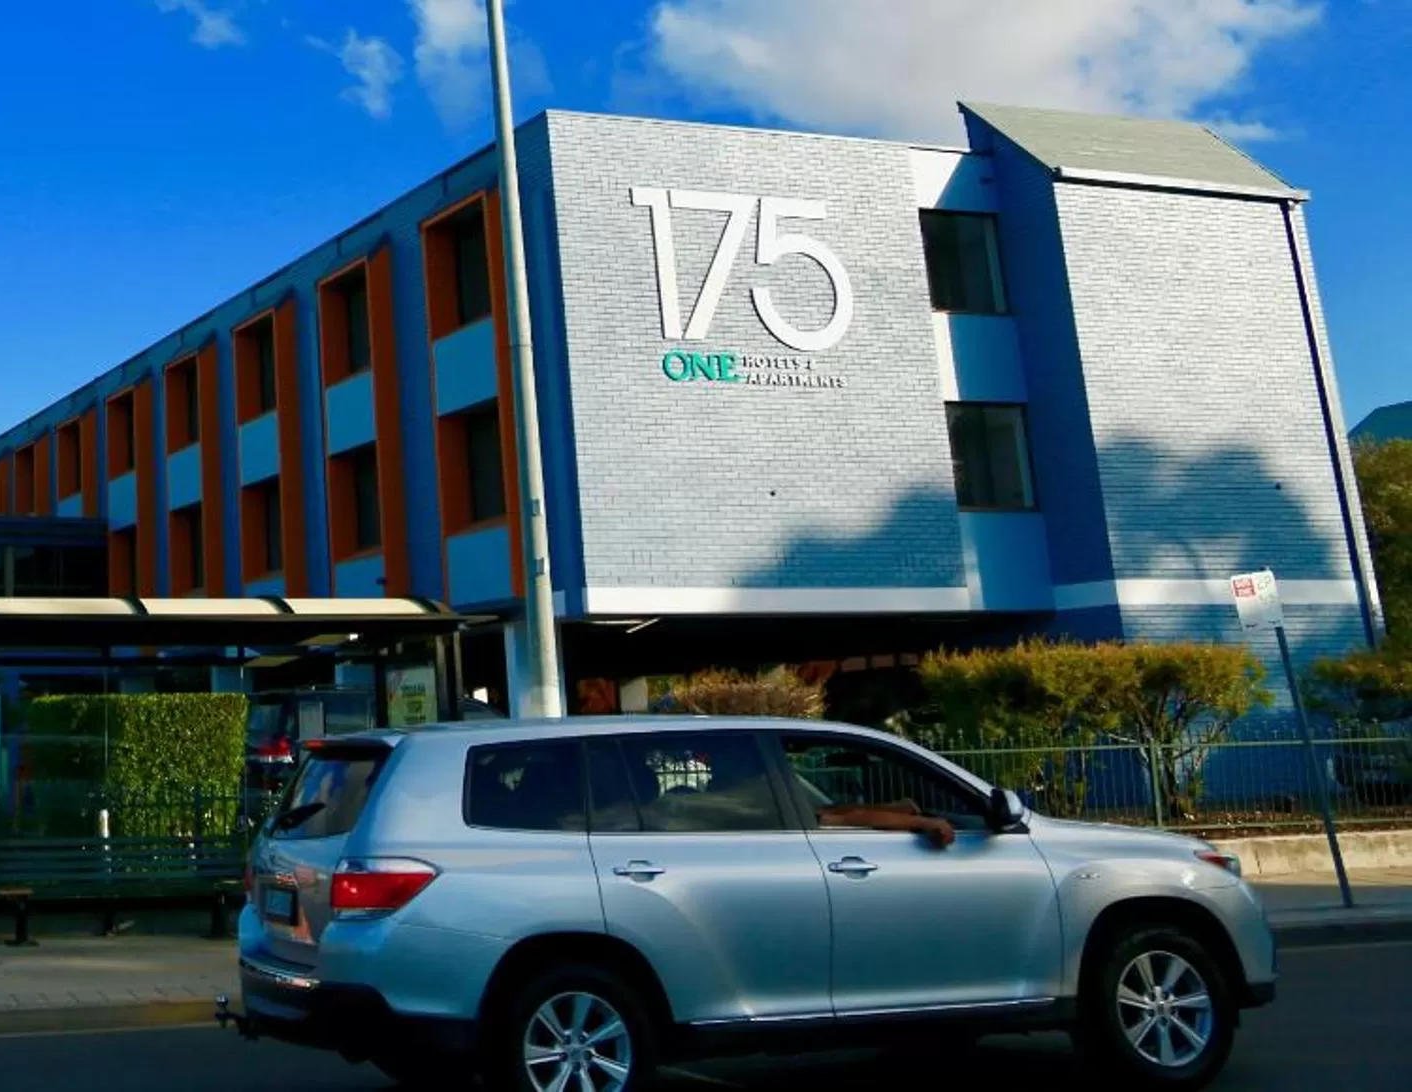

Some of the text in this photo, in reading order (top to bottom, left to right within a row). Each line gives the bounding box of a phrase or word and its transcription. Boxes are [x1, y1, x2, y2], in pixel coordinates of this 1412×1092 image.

[629, 187, 854, 352] 175
[661, 348, 739, 382] ONE
[742, 354, 801, 371] HOTELS
[745, 371, 849, 388] APARTMENTS
